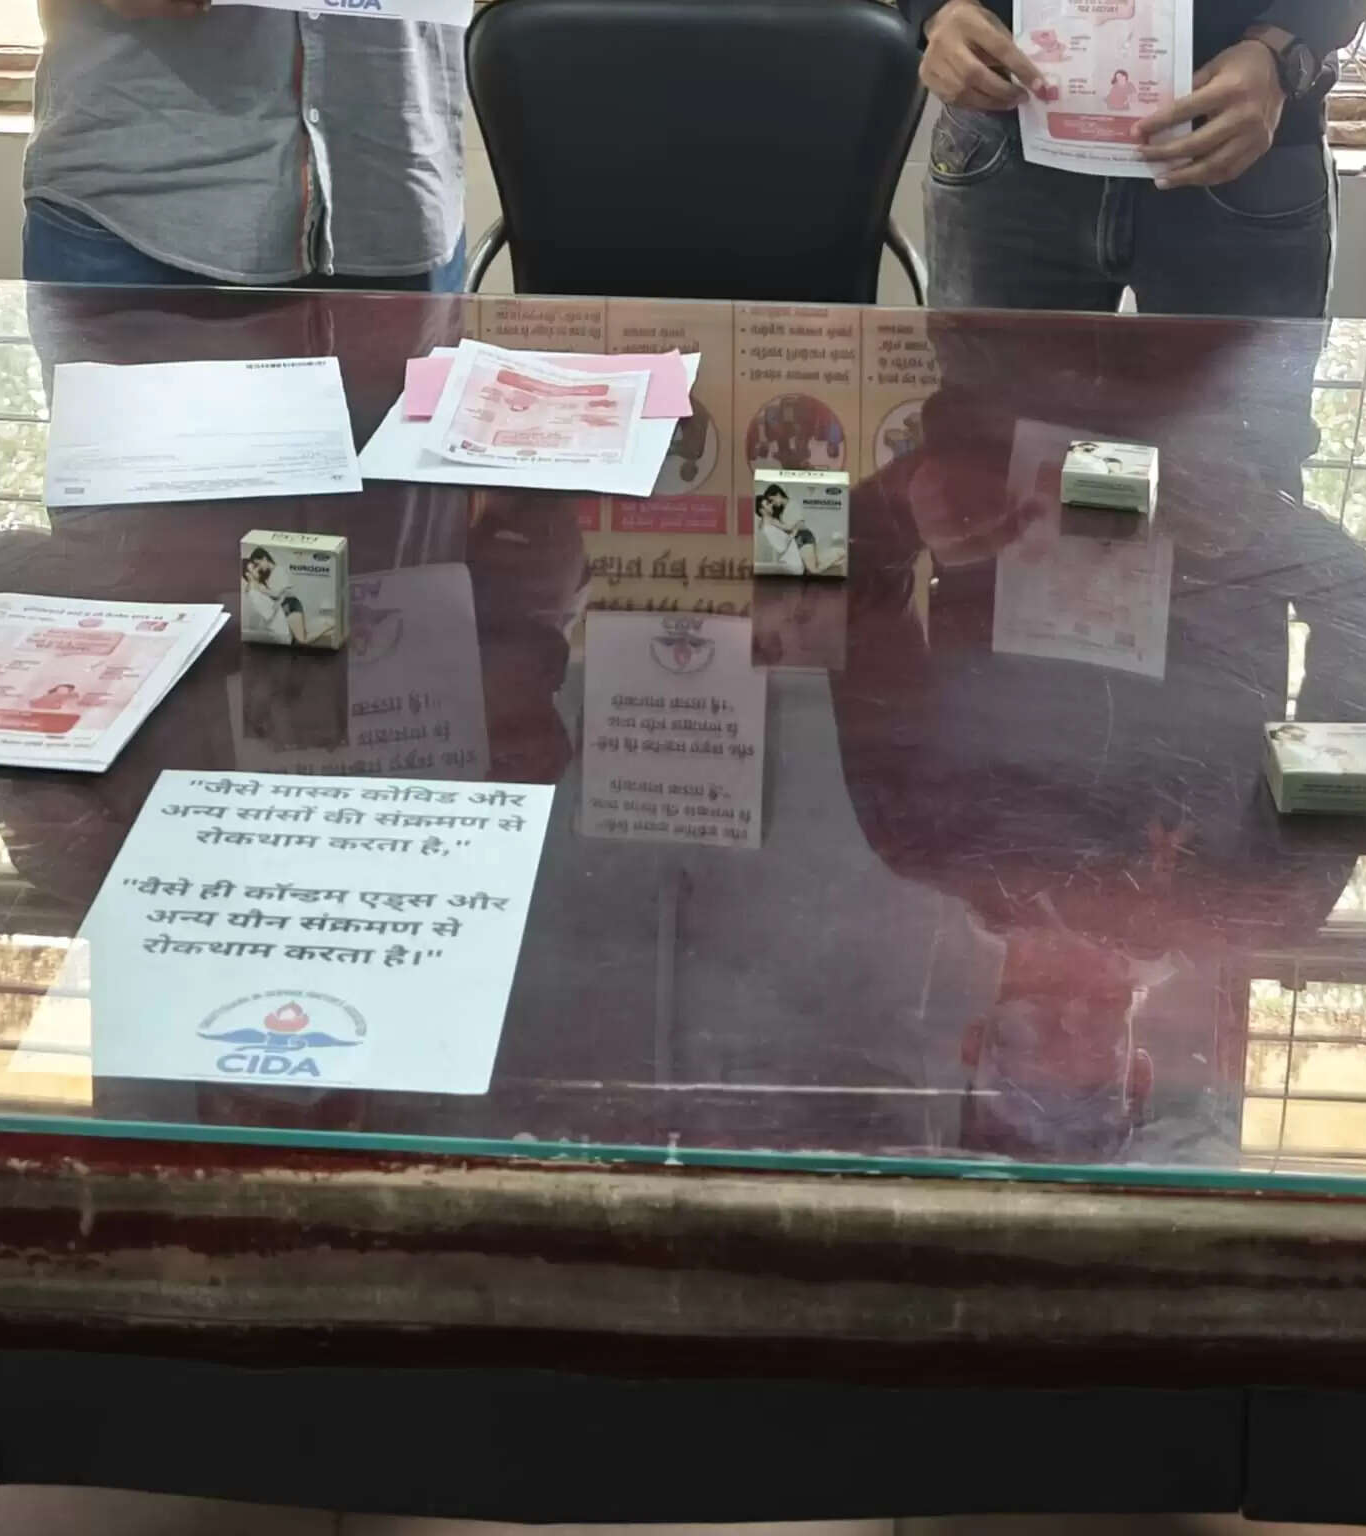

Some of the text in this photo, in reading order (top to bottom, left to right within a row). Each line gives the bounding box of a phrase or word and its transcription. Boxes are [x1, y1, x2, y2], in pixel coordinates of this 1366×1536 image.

[190, 778, 526, 807] "जैसे मास्क कोविड और
[161, 805, 229, 819] अन्य
[323, 808, 365, 824] की
[375, 810, 490, 829] संक्रमण
[499, 815, 526, 832] से
[196, 826, 470, 856] रोकथाम करता है,"
[123, 877, 193, 896] "वैसे
[200, 880, 237, 900] ही
[447, 892, 509, 911] और
[147, 909, 462, 937] अन्य यौन संक्रमण से
[143, 934, 442, 967] रोकथाम करता है।"
[216, 1053, 321, 1077] CIDA
